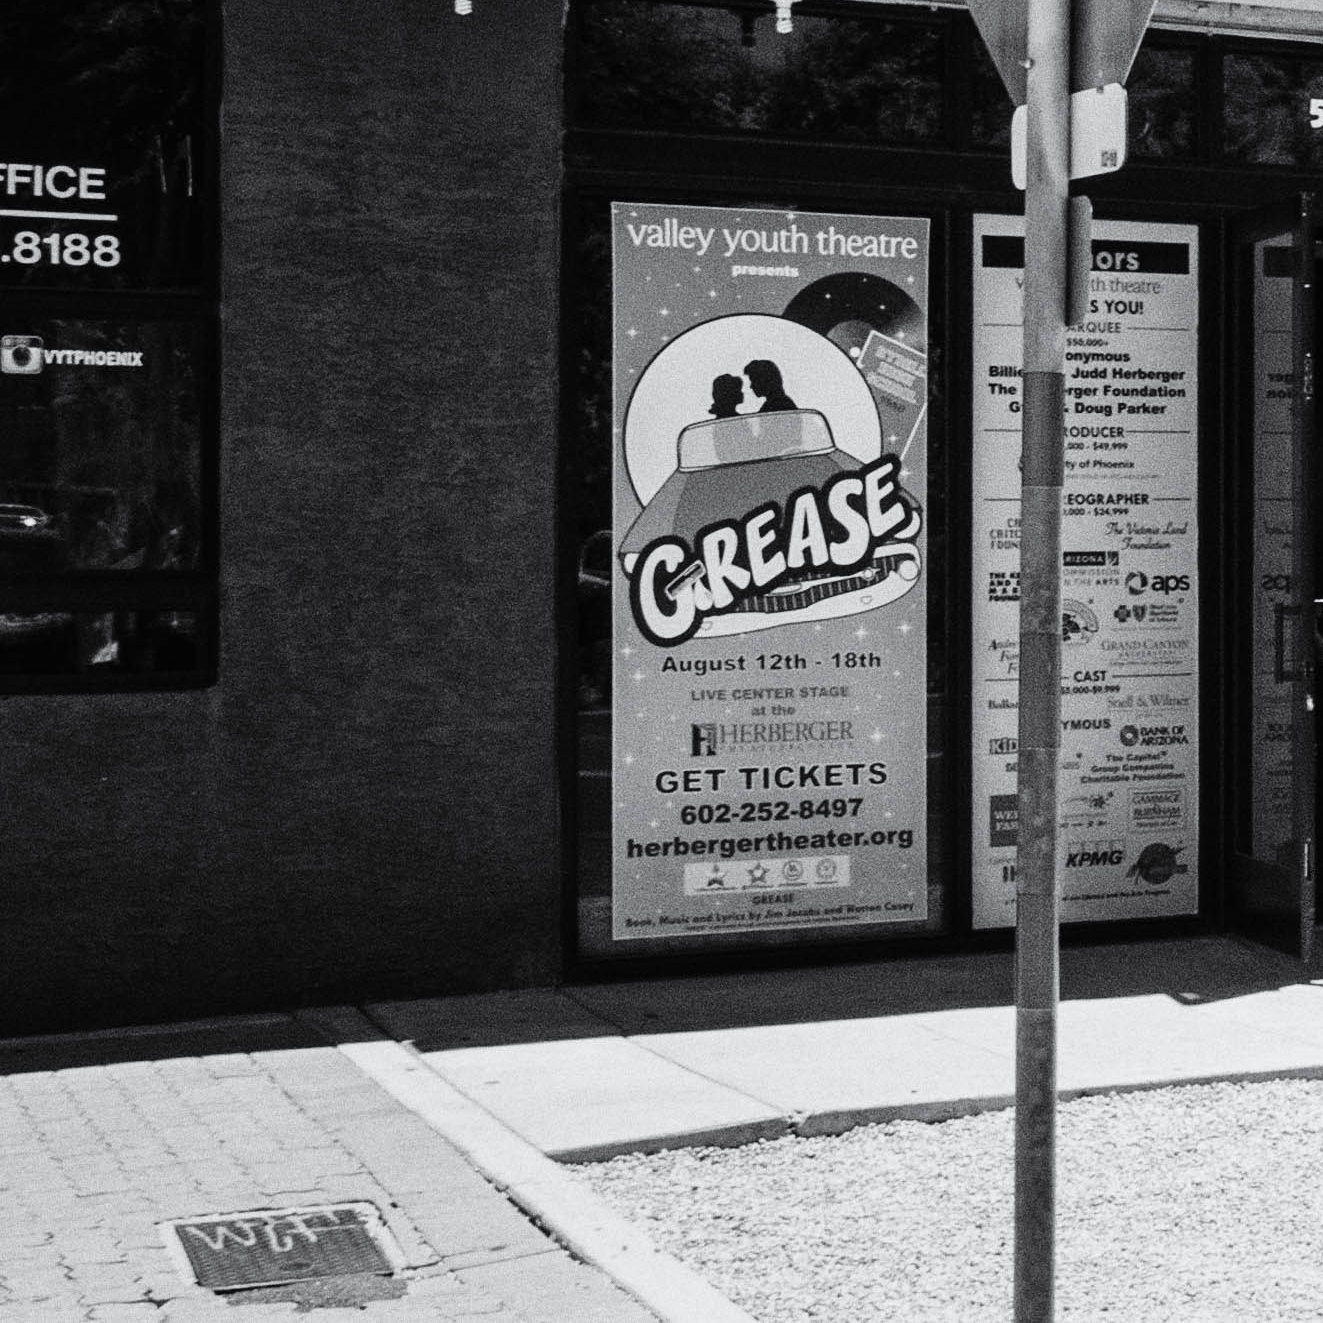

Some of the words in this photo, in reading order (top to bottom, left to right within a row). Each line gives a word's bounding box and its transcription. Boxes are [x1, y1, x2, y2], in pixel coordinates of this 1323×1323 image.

[0, 163, 106, 200] FICE
[626, 218, 715, 254] valley
[722, 225, 808, 257] youth
[817, 226, 918, 259] theatre
[1091, 250, 1140, 271] ors
[731, 262, 799, 278] presents
[1105, 300, 1144, 315] YOU!
[45, 349, 144, 367] VYTPHOENIX
[1065, 352, 1131, 363] onymous
[1071, 367, 1107, 379] Judd
[1111, 368, 1187, 382] Herberger
[988, 383, 1017, 395] The
[1103, 385, 1186, 398] Foundation
[1074, 403, 1112, 416] Doug
[1117, 403, 1167, 415] Parker
[1079, 459, 1091, 469] of
[1092, 460, 1135, 469] Phoenix
[1066, 493, 1149, 505] EOGRAPHER
[636, 459, 906, 642] GREASE
[1064, 554, 1104, 564] RIZONA
[1151, 574, 1190, 595] aps
[661, 656, 746, 676] August
[755, 653, 807, 671] 12th
[831, 652, 882, 669] 18th
[1073, 670, 1107, 682] CAST
[691, 689, 727, 701] LIVE
[732, 688, 795, 701] CENTER
[799, 686, 849, 698] STAGE
[751, 706, 766, 716] at
[771, 704, 796, 716] the
[1061, 718, 1112, 731] YMOUS
[1140, 726, 1169, 737] BANK
[720, 721, 854, 744] HERBERGER
[656, 769, 726, 794] GET
[739, 763, 888, 790] TICKETS
[680, 797, 864, 826] 602-252-8497
[627, 829, 914, 859] herbergertheater.org
[1066, 850, 1124, 868] KPMG
